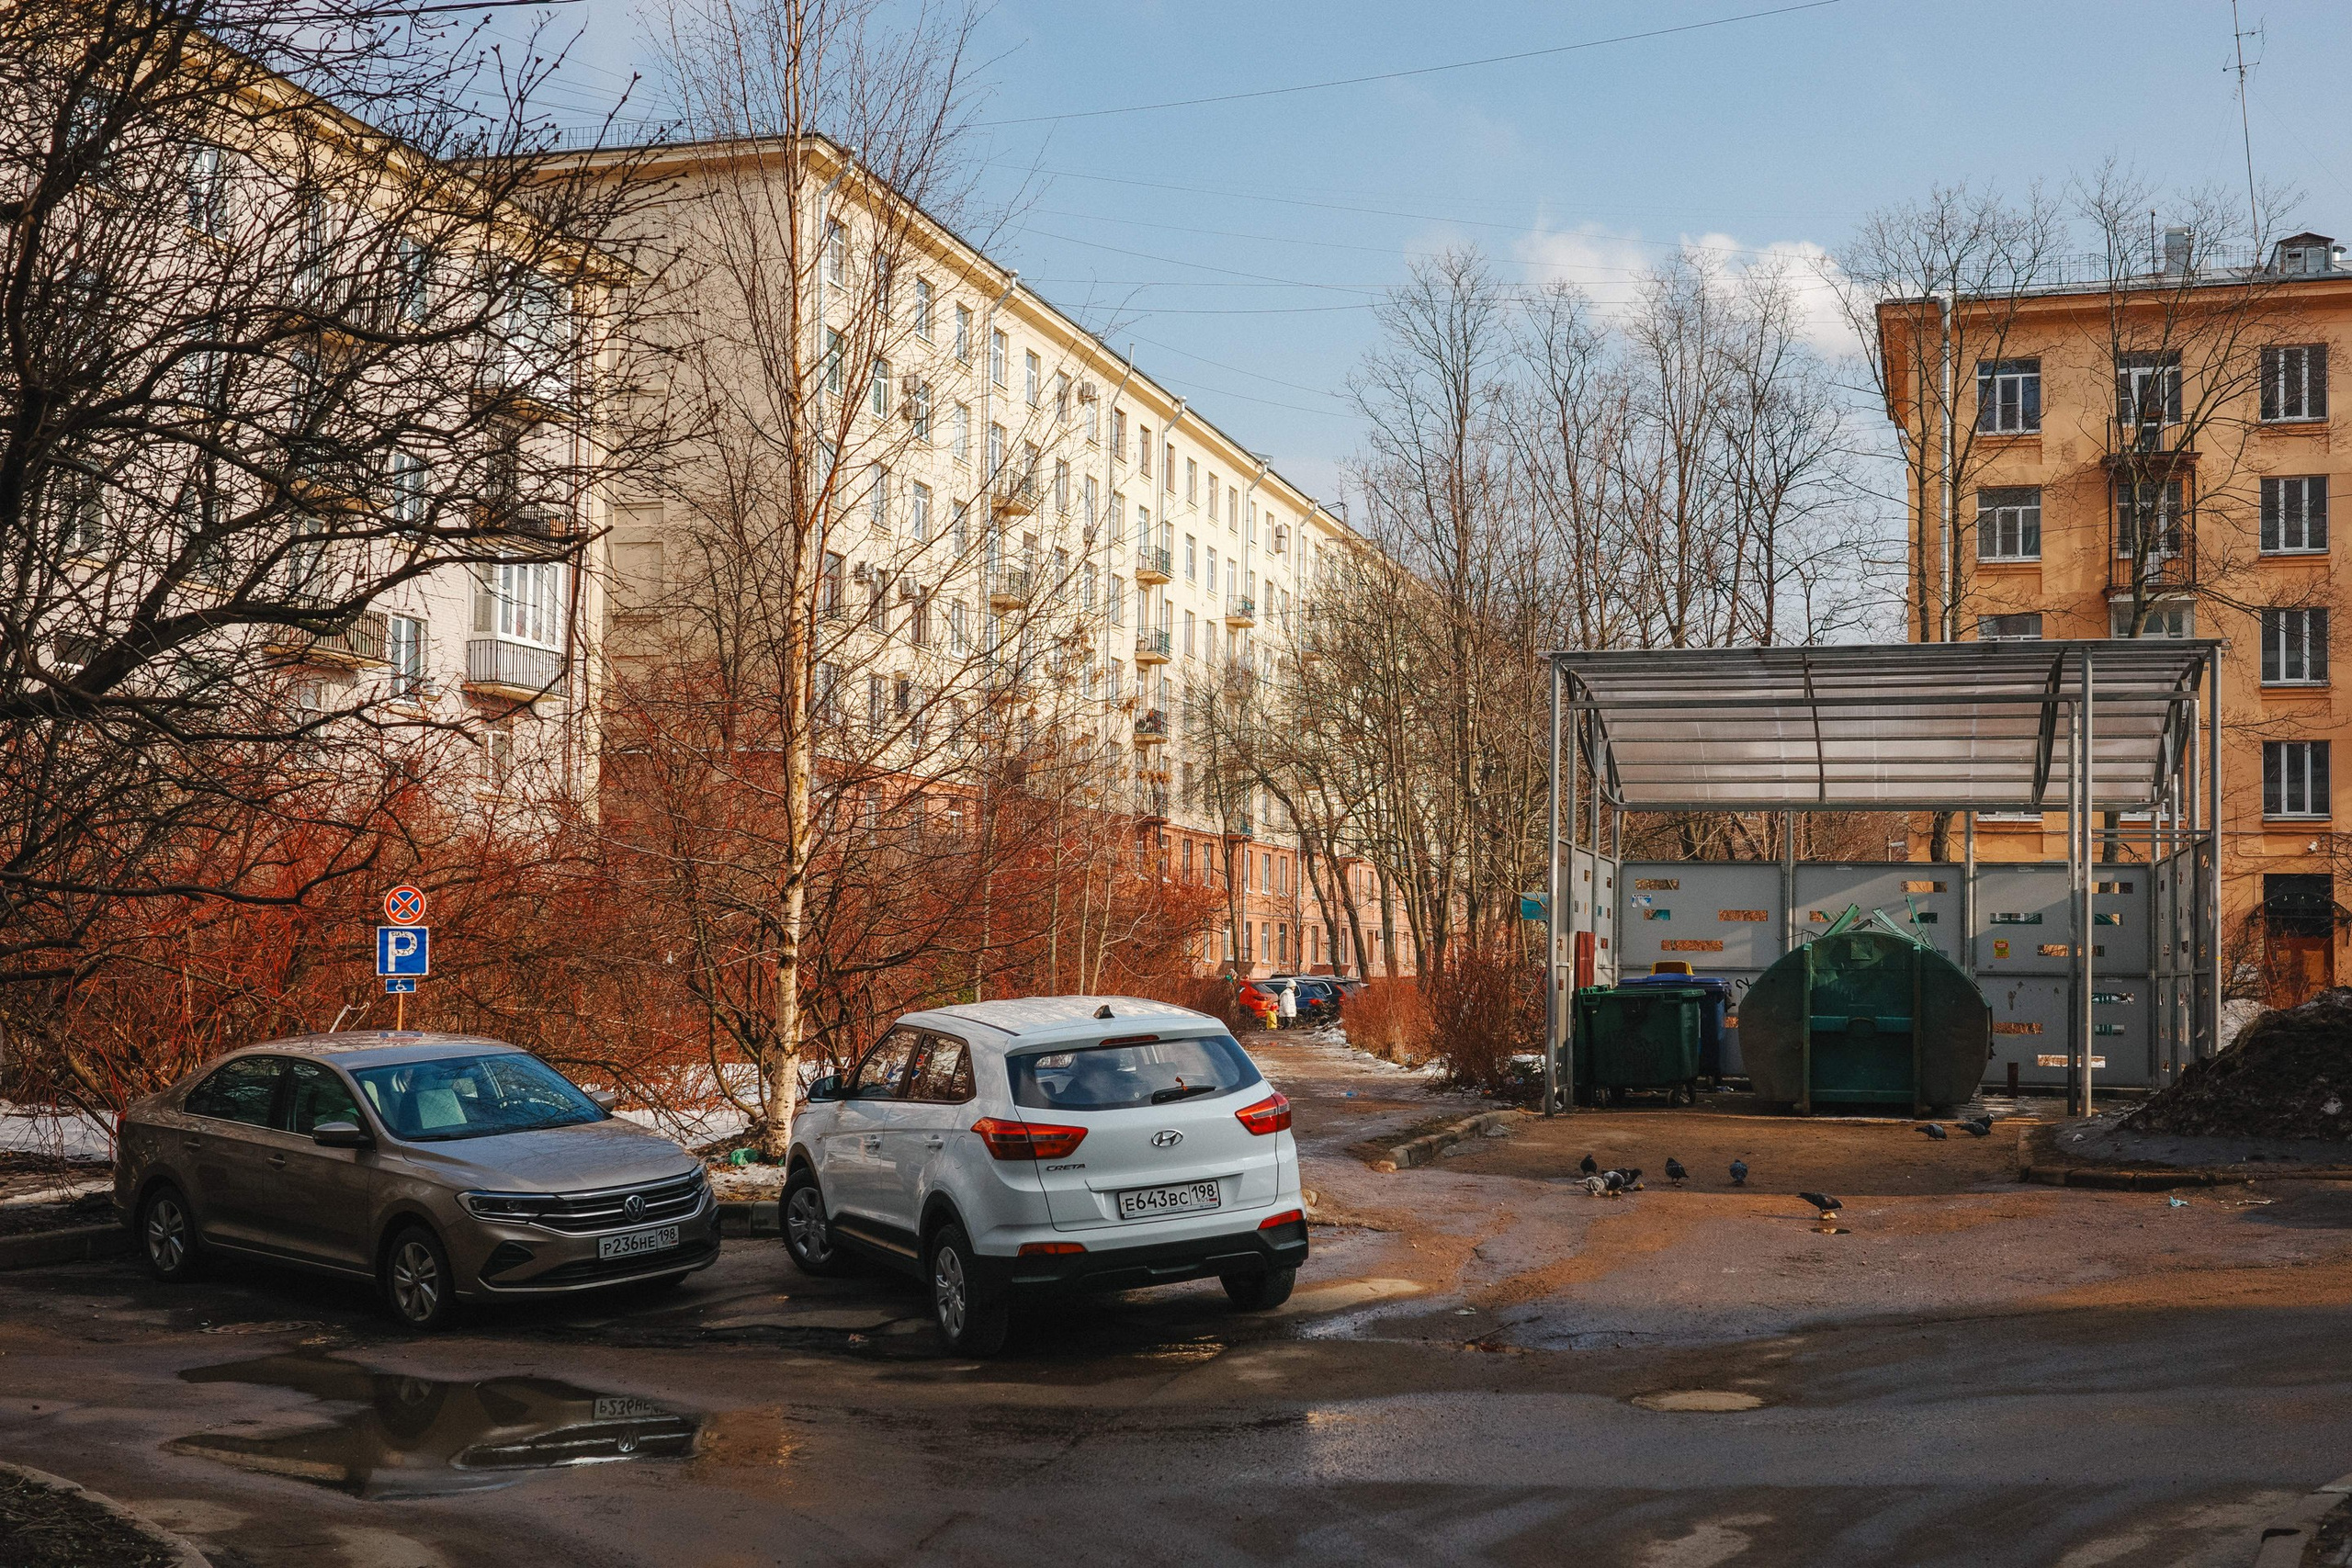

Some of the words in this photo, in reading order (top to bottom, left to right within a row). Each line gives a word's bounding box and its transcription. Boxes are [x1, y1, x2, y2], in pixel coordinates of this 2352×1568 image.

[388, 931, 417, 972] P
[1046, 1163, 1086, 1171] CRETA
[1125, 1190, 1189, 1212] Е643ВС
[1192, 1184, 1215, 1199] 198
[604, 1235, 655, 1255] Р236НЕ
[658, 1228, 675, 1242] 198
